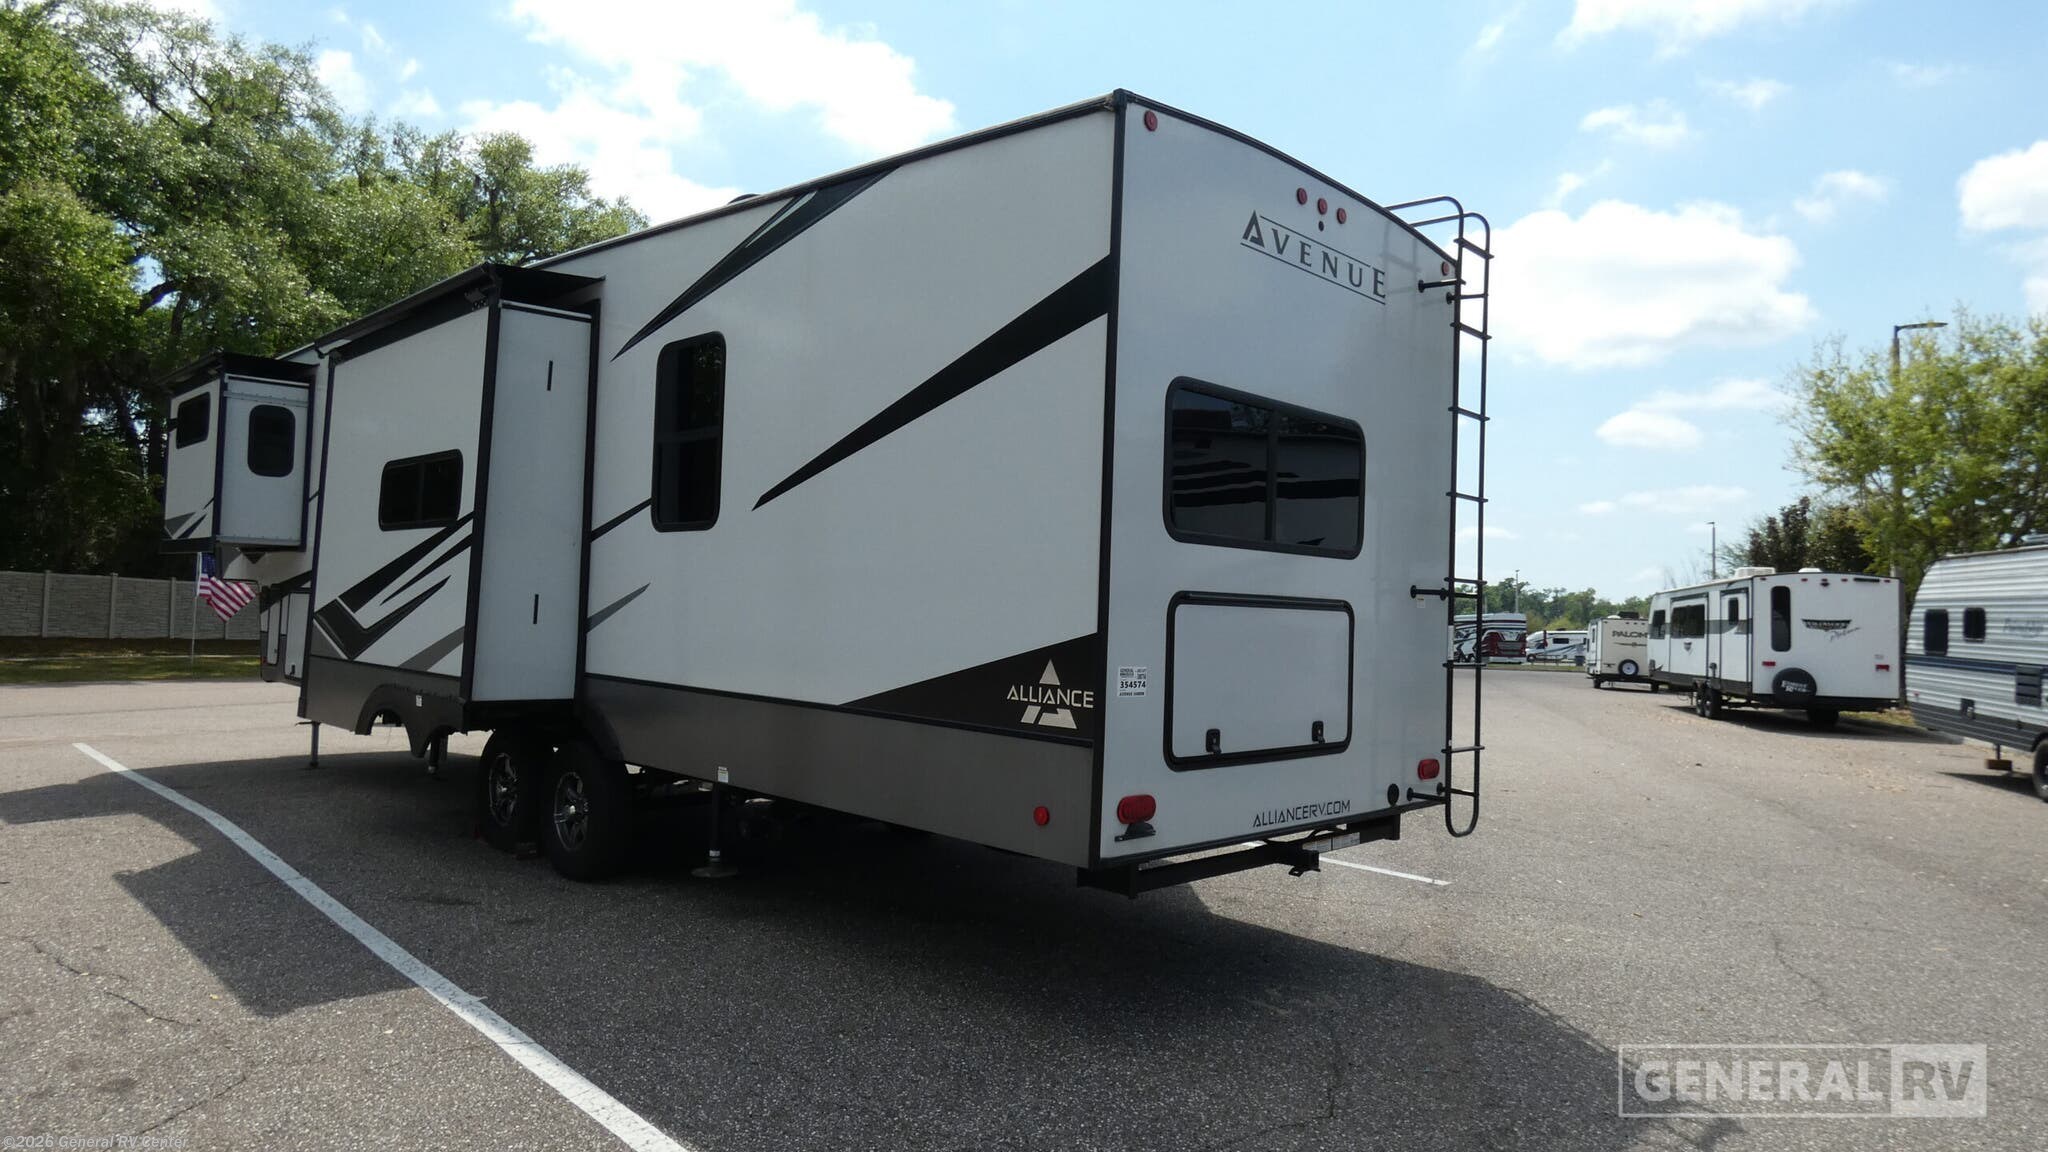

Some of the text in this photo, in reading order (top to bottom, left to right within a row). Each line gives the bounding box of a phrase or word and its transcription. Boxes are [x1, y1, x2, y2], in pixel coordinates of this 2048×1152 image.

[1242, 210, 1386, 299] AVENUE
[1006, 685, 1095, 708] ALLIANCE
[1119, 680, 1146, 689] 354574
[1253, 799, 1351, 828] ALLIANCERV.COM
